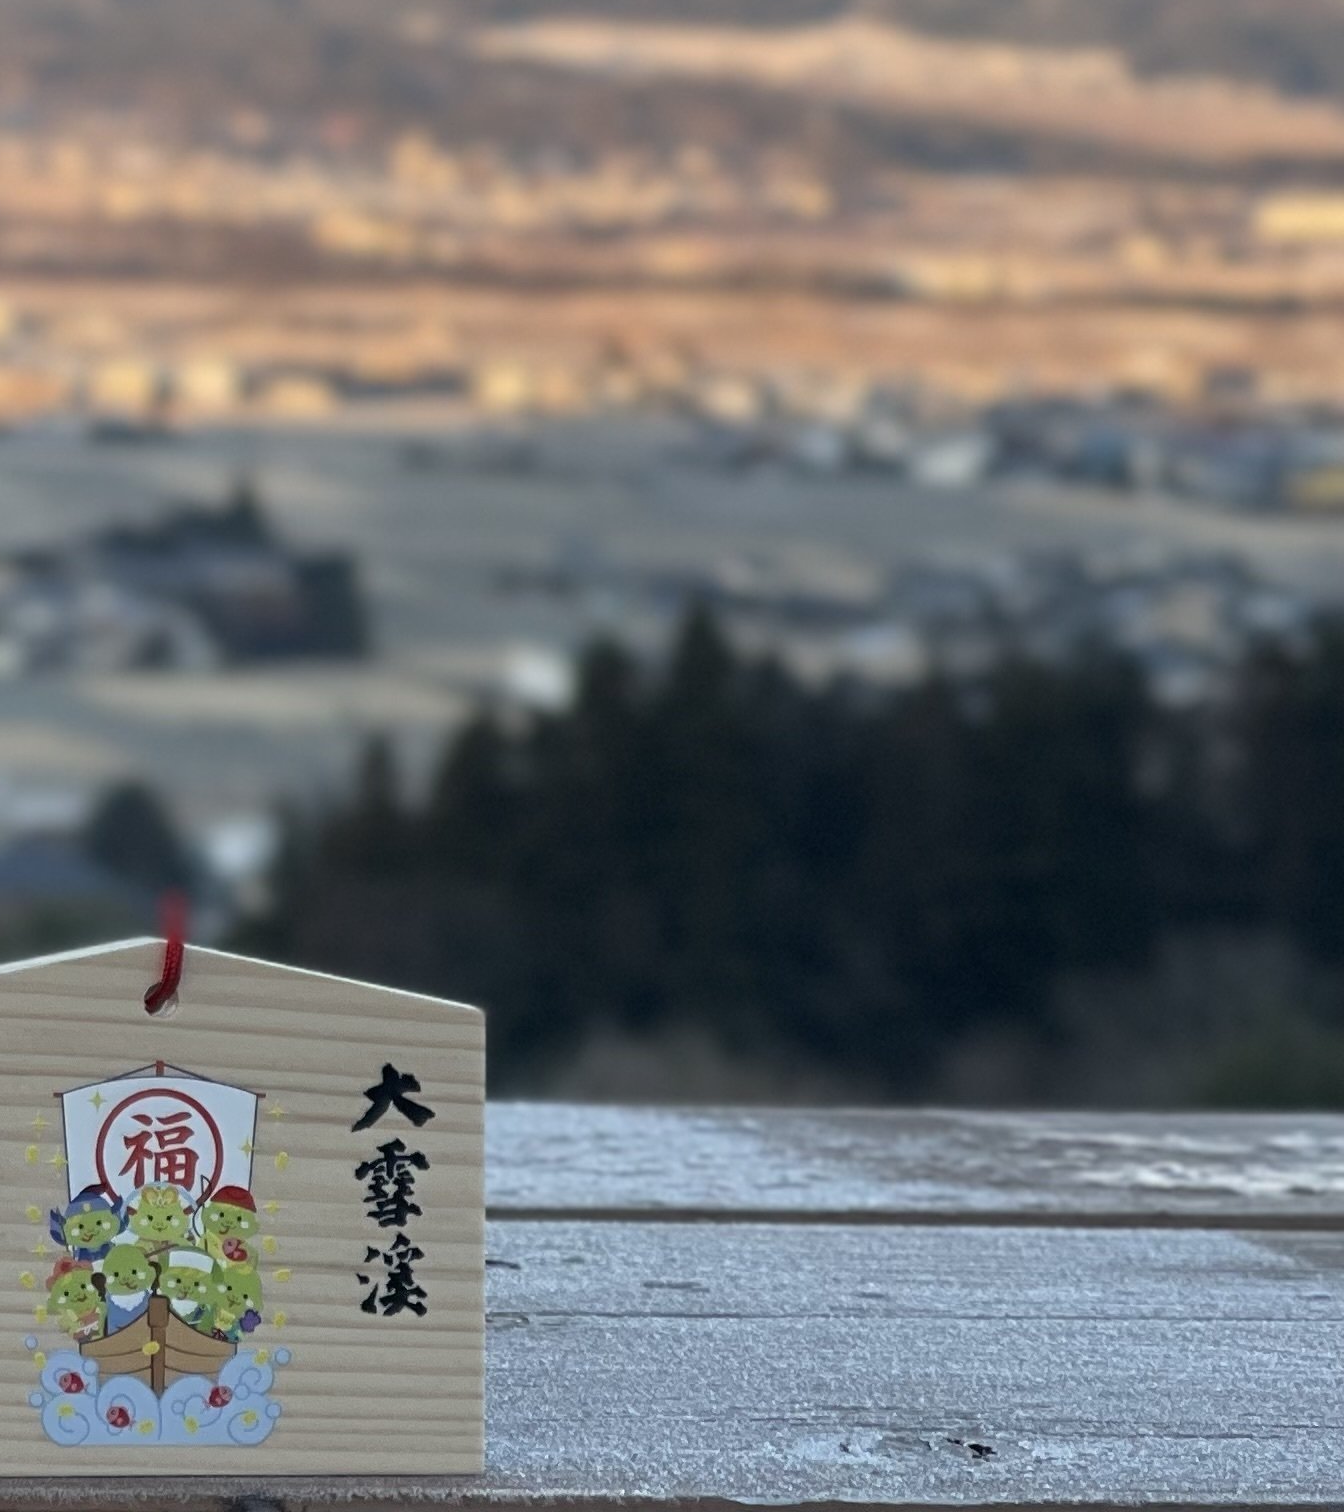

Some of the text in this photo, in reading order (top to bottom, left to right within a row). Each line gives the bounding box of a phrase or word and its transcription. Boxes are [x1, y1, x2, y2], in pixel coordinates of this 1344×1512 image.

[119, 1111, 199, 1188] 福
[350, 1062, 436, 1318] 大雪渓
